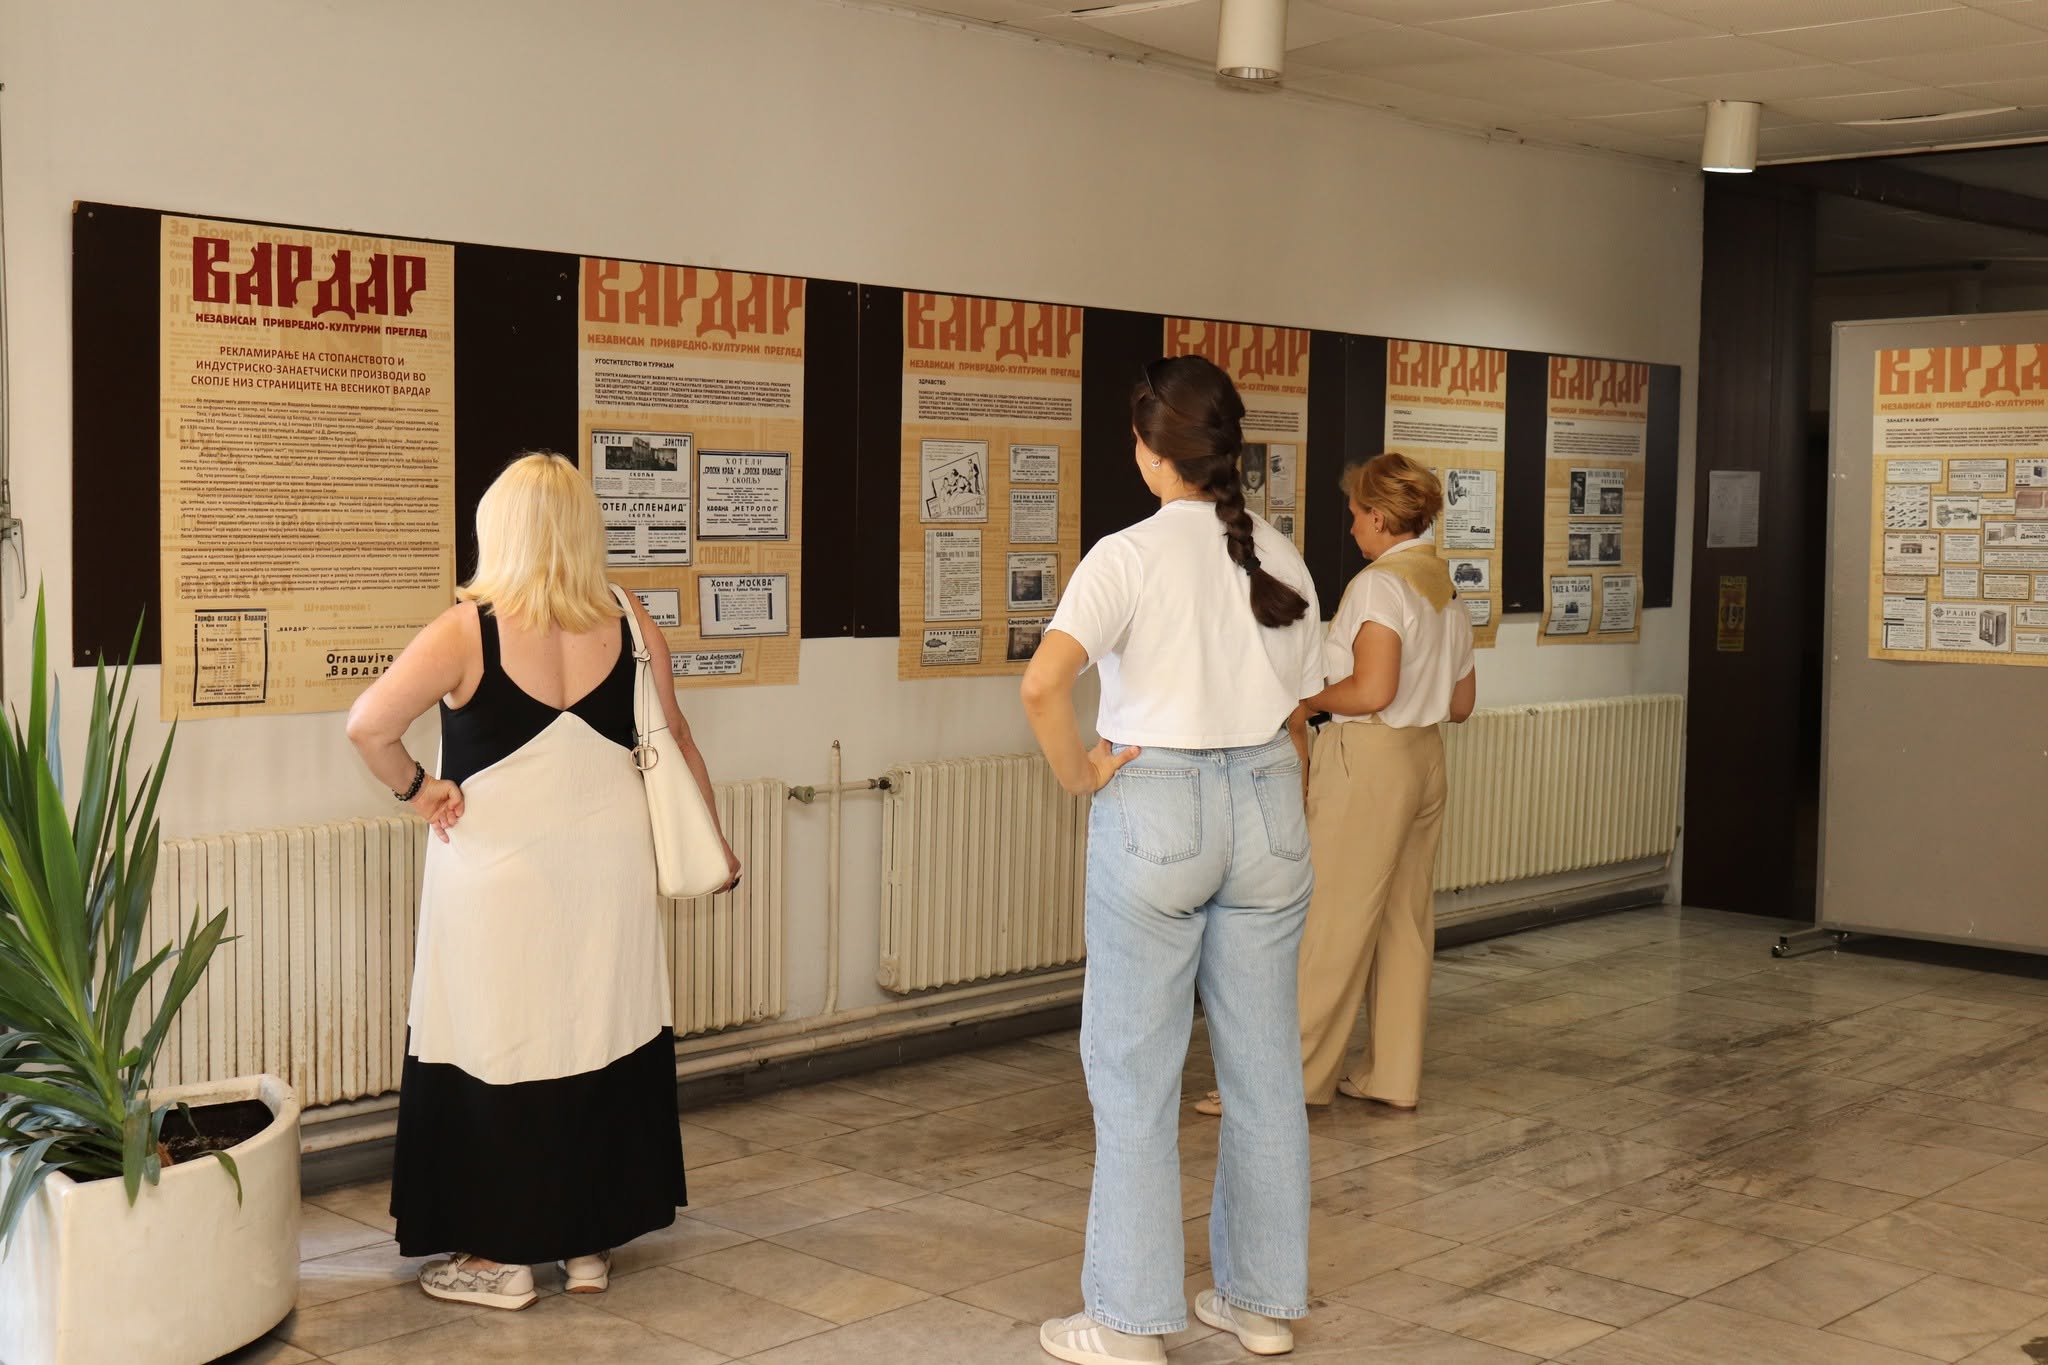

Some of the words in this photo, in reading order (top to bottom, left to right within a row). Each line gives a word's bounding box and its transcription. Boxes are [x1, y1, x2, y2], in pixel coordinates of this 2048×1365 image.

[193, 236, 426, 320] ВАРДАР
[585, 258, 803, 340] ВАРДАР
[195, 313, 257, 326] НЕЗАВИСАН
[263, 317, 381, 335] ПРИВРЕДНО-КУЛТУРНИ
[385, 327, 428, 338] ПРЕГЛЕД
[907, 292, 1081, 363] ВАРДАР
[587, 333, 645, 347] НЕЗАВИСАН
[650, 338, 760, 354] ПРИВРЕДНО-КУЛТУРНИ
[764, 346, 802, 357] ПРЕГЛЕД
[220, 346, 300, 360] РЕКЛАМИРАЊЕ
[303, 351, 316, 361] НА
[318, 351, 395, 366] СТОПАНСТВОТО
[398, 357, 404, 366] И
[595, 358, 642, 368] УГОСТИТЕЛСТВО
[648, 361, 674, 369] ТУРИЗАМ
[196, 360, 348, 378] ИНДУСТРИСКО-ЗАНАЕТЧИСКИ
[350, 369, 410, 383] ПРОИЗВОДИ
[413, 372, 426, 382] ВО
[909, 359, 955, 370] НЕЗАВИСАН
[959, 362, 1047, 376] ПРИВРЕДНО-КУЛТУРНИ
[1050, 368, 1081, 378] ПРЕГЛЕД
[1389, 339, 1505, 396] ВАРДАР
[191, 375, 230, 388] СКОПЈЕ
[233, 377, 253, 388] НИЗ
[256, 379, 322, 393] СТРАНИЦИТЕ
[325, 383, 338, 393] НА
[340, 383, 390, 395] ВЕСНИКОТ
[393, 386, 431, 398] ВАРДАР
[918, 378, 946, 386] ЗДРАВСТВО
[1550, 356, 1647, 408] ВАРДАР
[725, 457, 762, 465] ХОТЕЛИ
[732, 476, 761, 485] СКОПЉУ
[599, 502, 627, 511] ОТЕЛ
[711, 579, 734, 588] Хотел
[326, 653, 394, 665] Оглашујте
